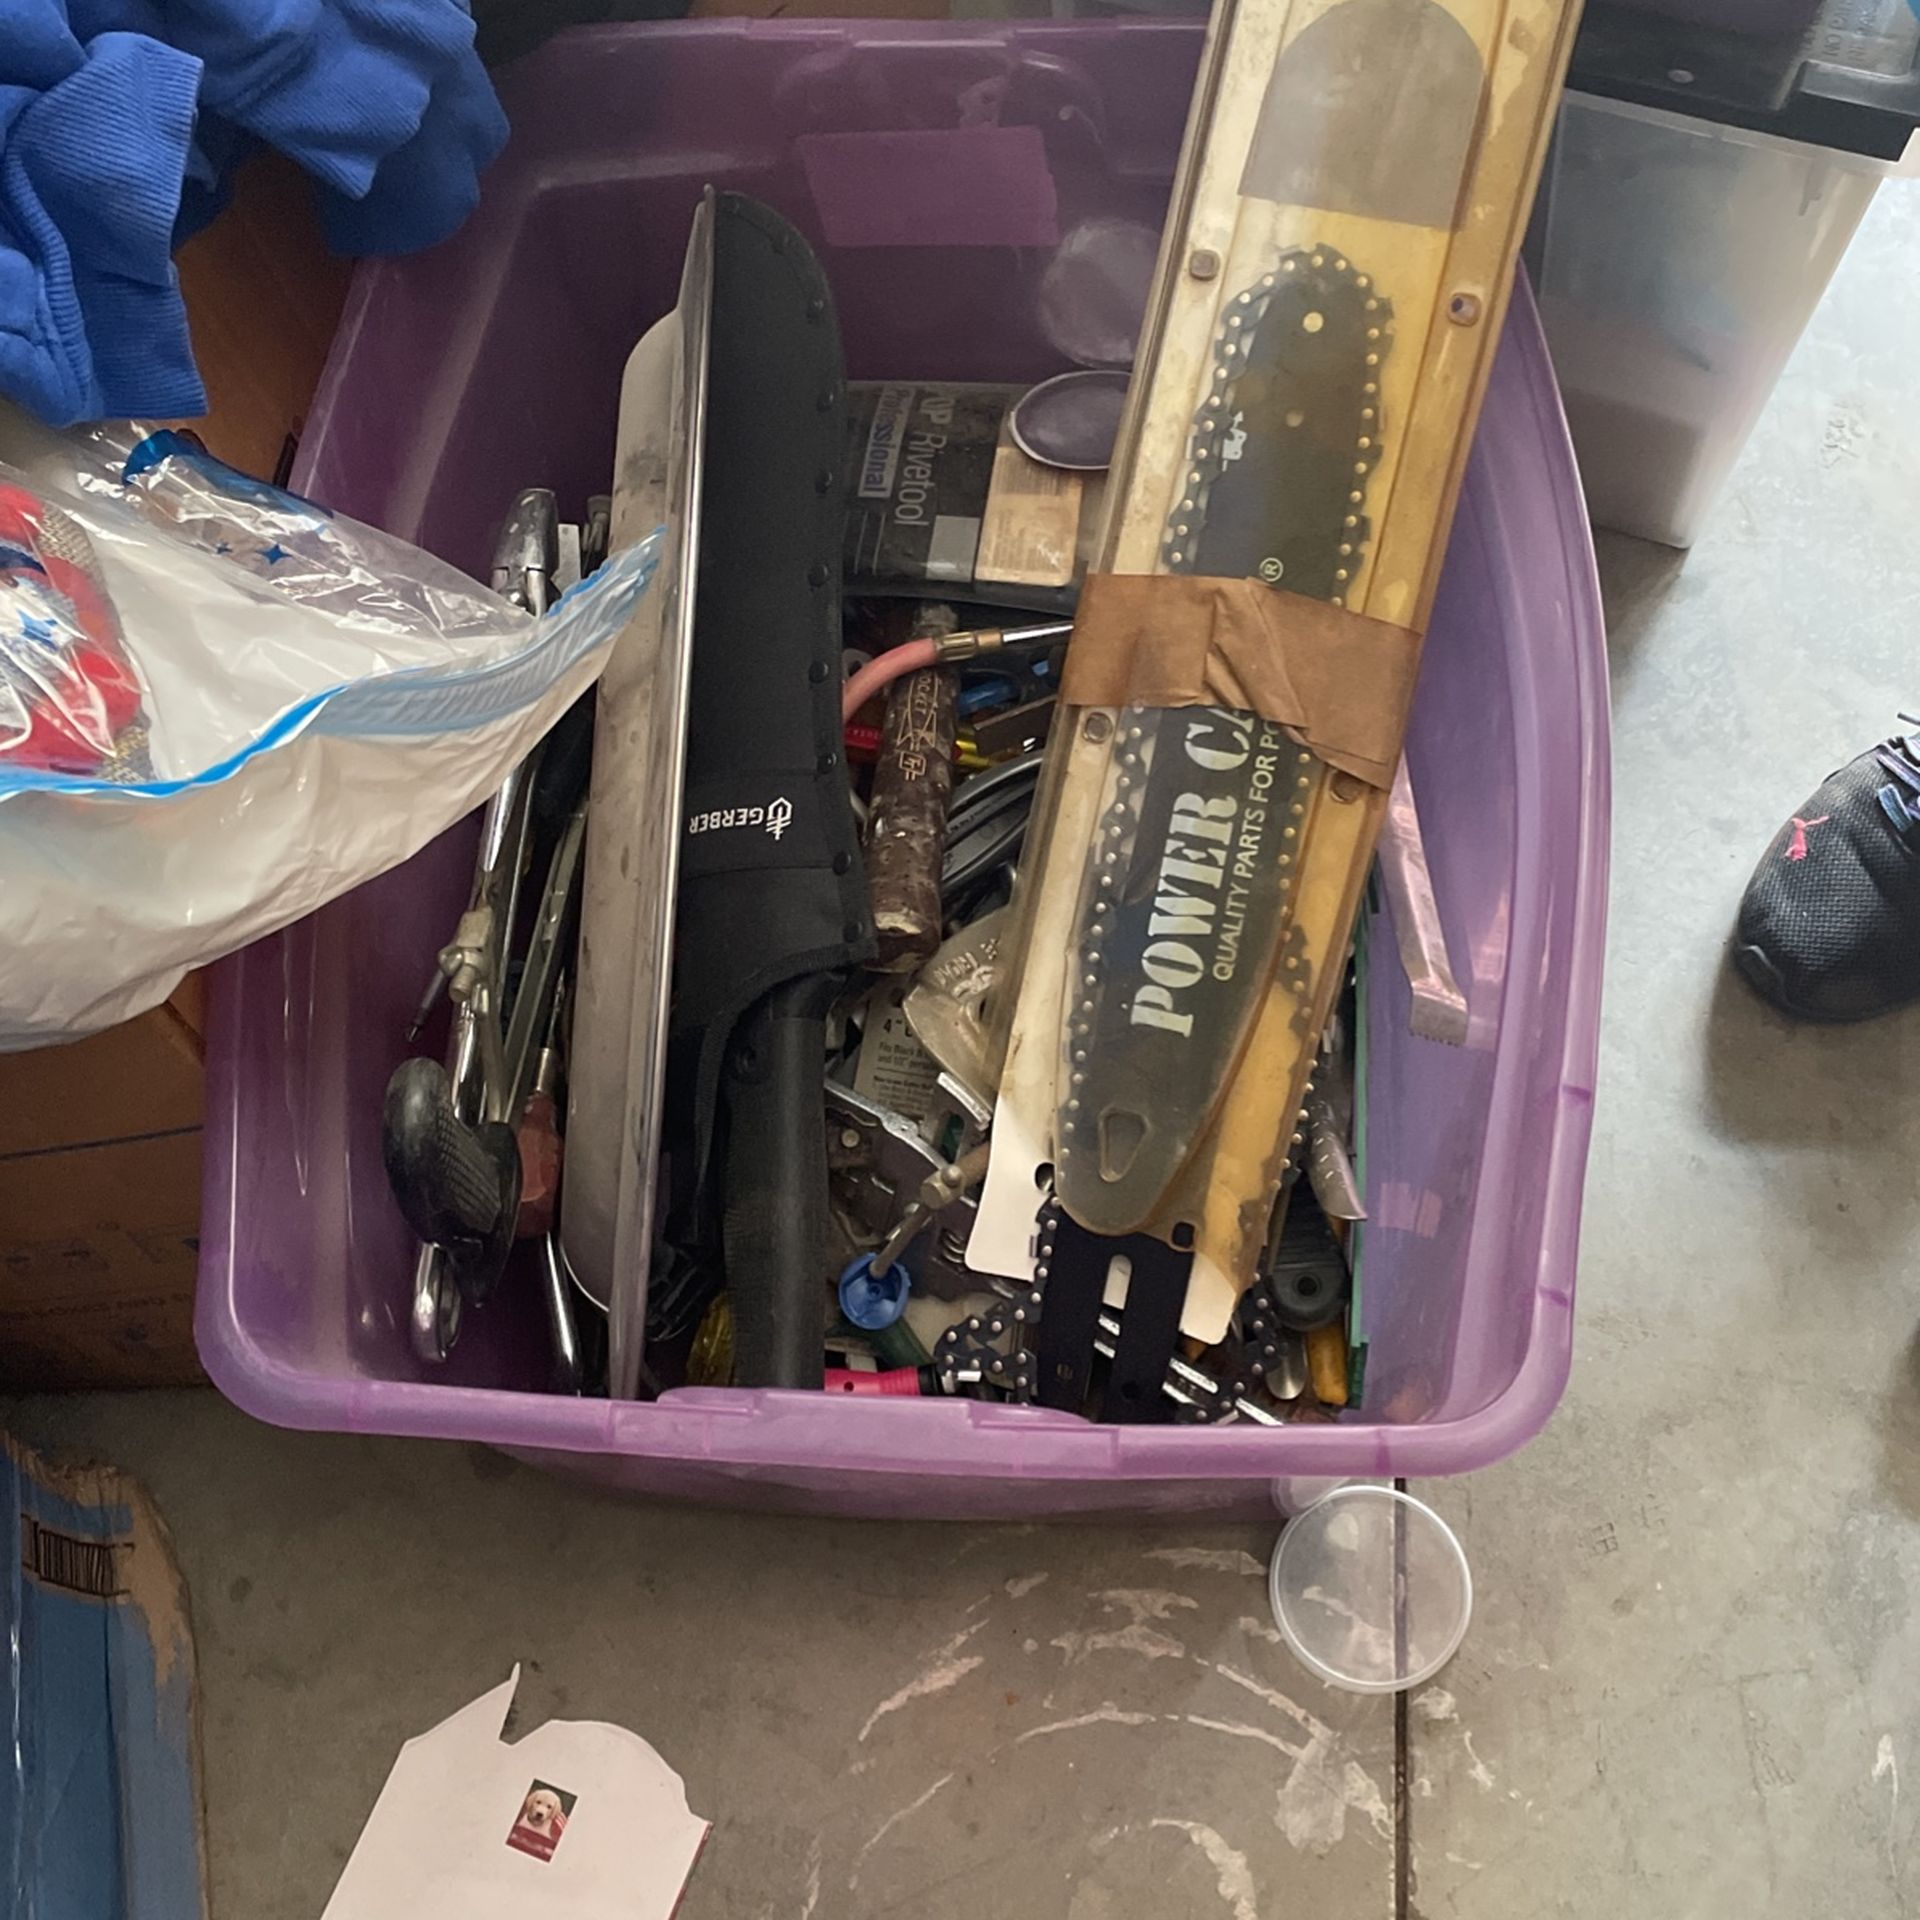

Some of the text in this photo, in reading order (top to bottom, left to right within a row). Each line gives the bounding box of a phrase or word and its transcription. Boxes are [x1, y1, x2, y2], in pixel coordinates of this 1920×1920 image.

[863, 388, 907, 492] Professional
[894, 430, 947, 526] Rivetool
[914, 676, 931, 715] OCKET
[689, 807, 764, 834] GERBER
[1212, 882, 1250, 981] QUALITY
[1233, 808, 1265, 878] PARTS
[1250, 755, 1278, 802] FOR
[1131, 792, 1238, 1037] POWER
